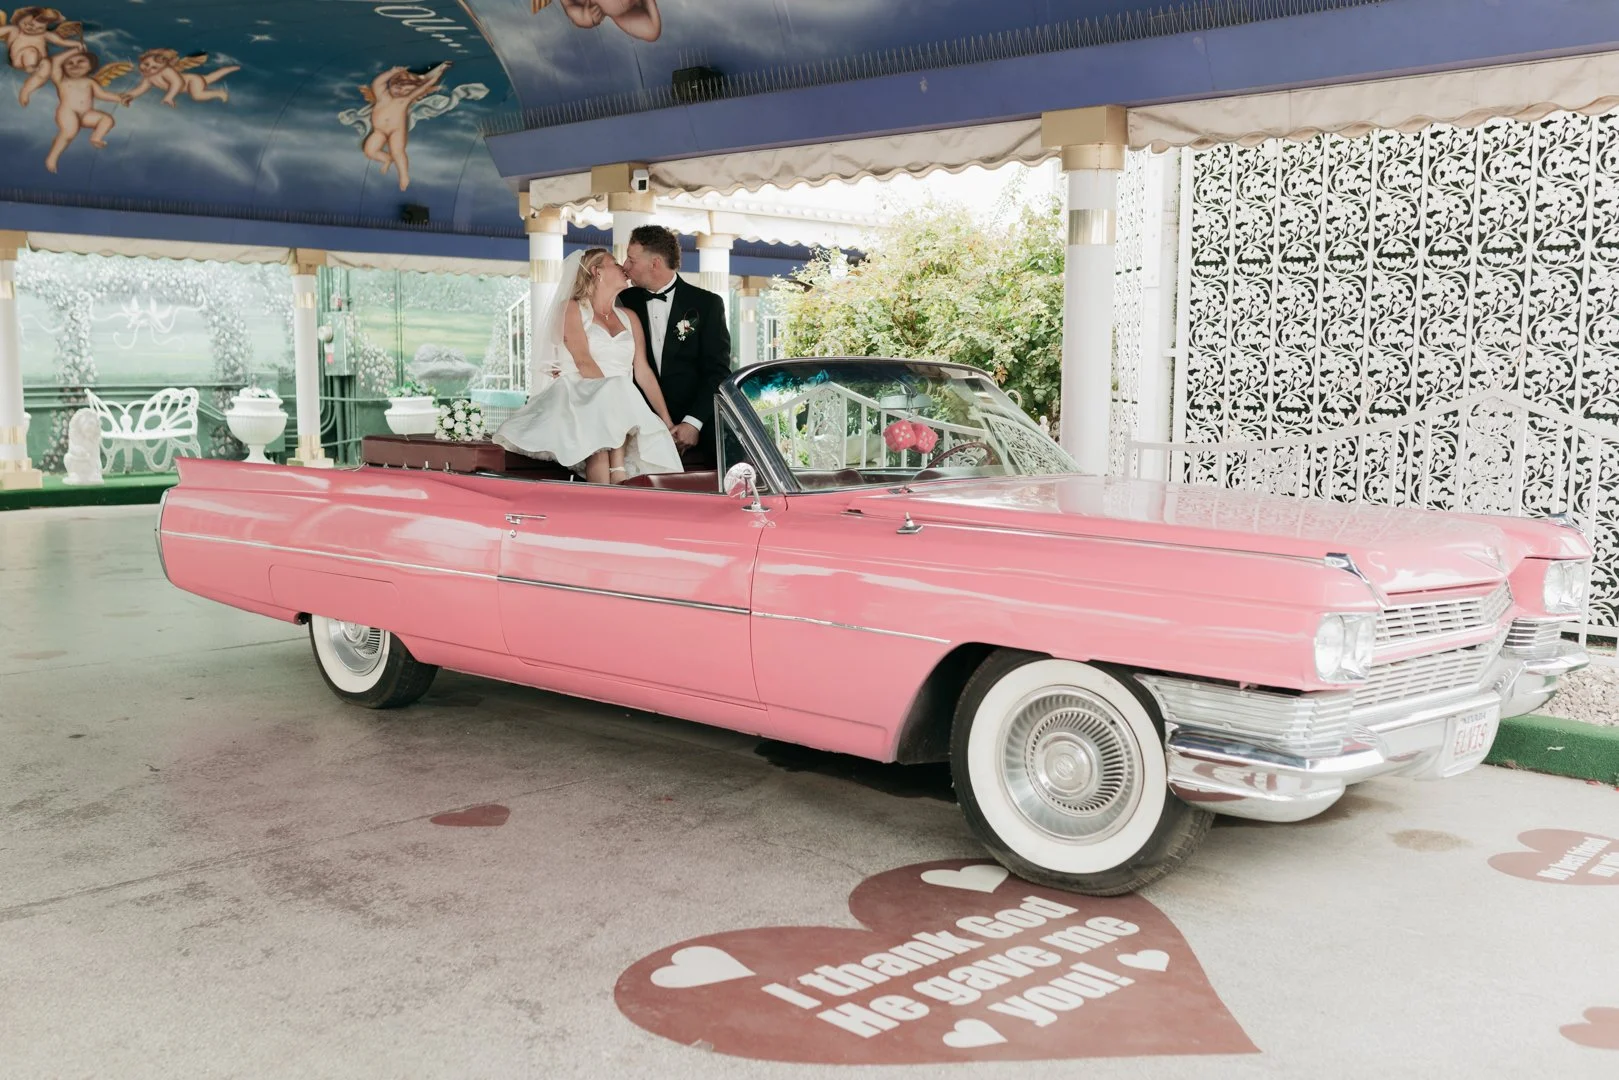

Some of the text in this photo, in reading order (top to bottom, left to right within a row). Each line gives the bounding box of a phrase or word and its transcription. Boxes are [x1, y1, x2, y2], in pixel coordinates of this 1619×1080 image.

[1454, 723, 1488, 756] ELVIS
[761, 895, 1079, 1010] I thank God
[816, 916, 1141, 1039] He gave me
[986, 962, 1136, 1028] you!
